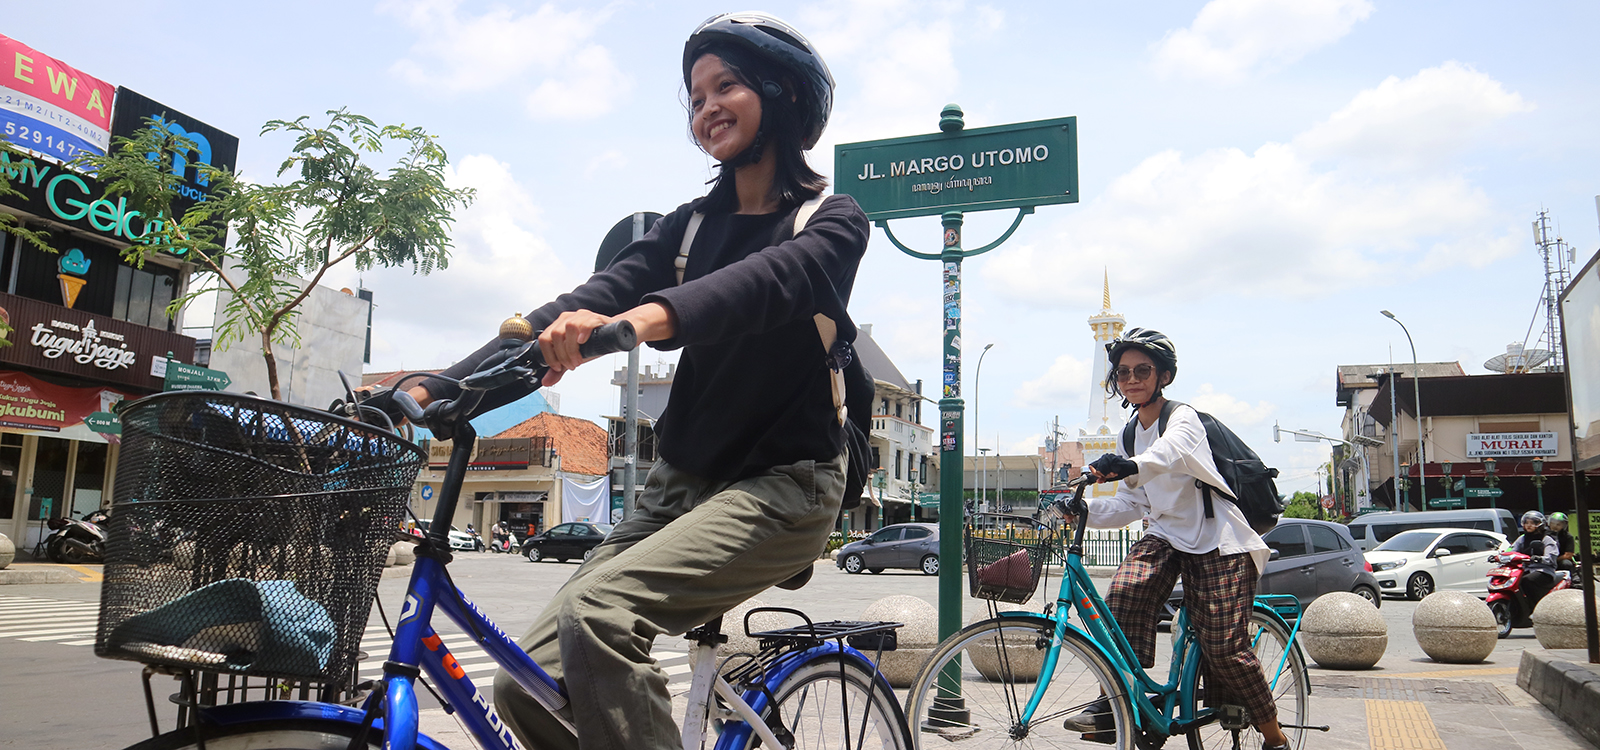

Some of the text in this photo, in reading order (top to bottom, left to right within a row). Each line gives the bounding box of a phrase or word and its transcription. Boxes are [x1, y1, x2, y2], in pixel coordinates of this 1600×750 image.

[857, 143, 1049, 181] JL. MARGO UTOMO
[30, 322, 82, 359] tugu
[74, 337, 136, 370] jogja
[177, 366, 205, 377] MONJALI
[1481, 440, 1543, 450] MURAH
